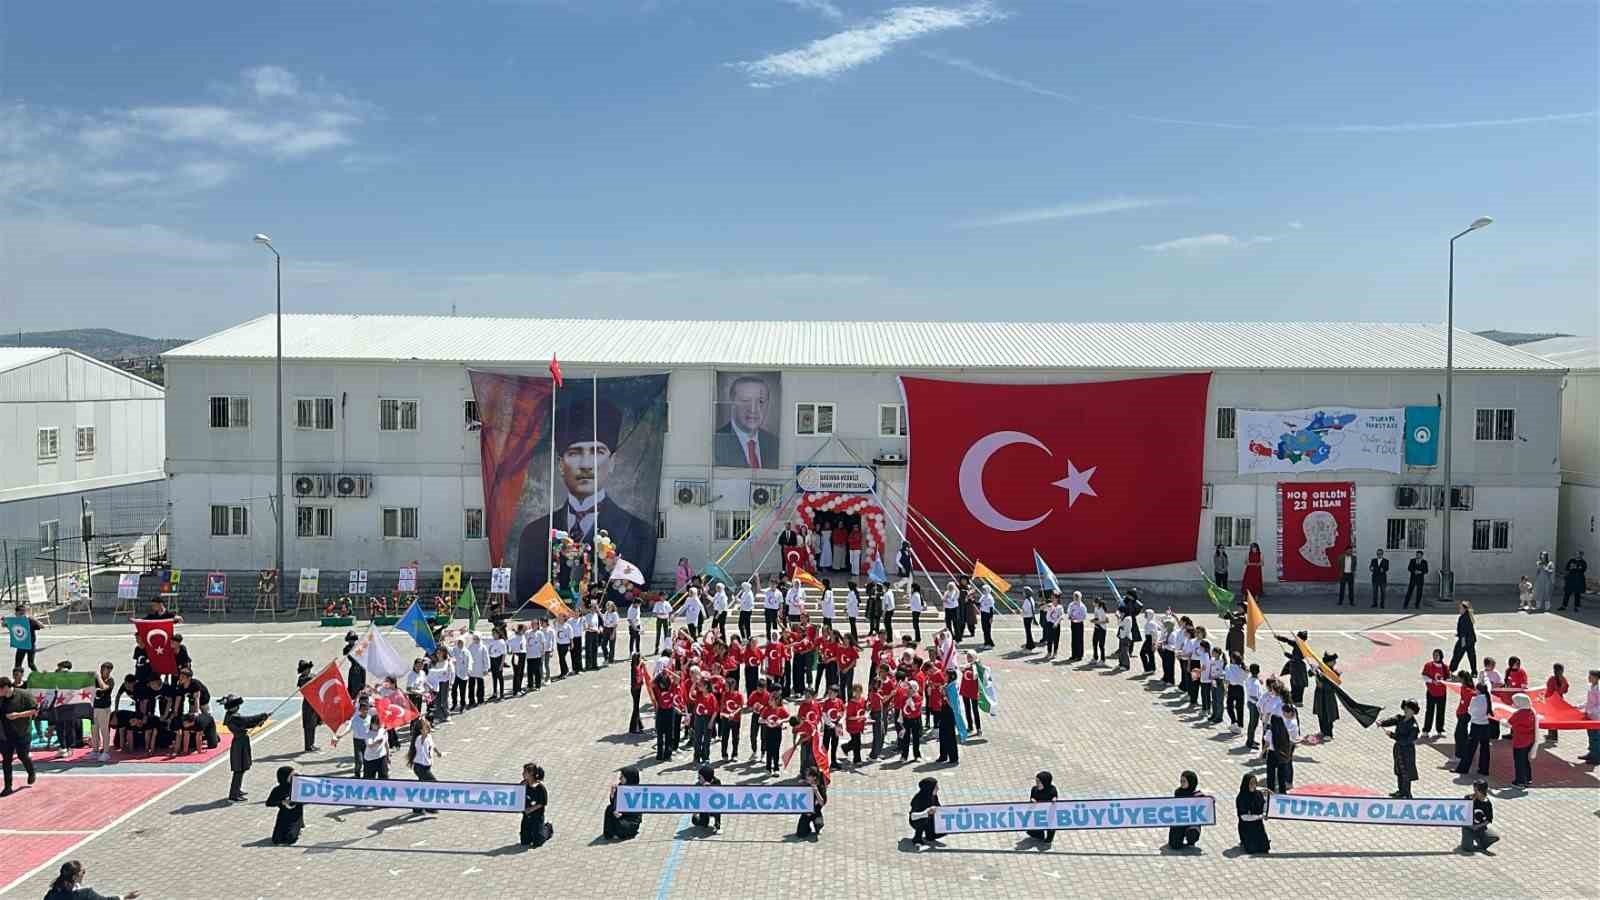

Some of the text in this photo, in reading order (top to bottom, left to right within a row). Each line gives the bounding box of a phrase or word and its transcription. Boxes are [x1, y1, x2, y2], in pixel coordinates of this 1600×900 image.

[1287, 489, 1347, 500] HOŞ GELDİN
[1293, 499, 1342, 510] 23 NİSAN
[300, 780, 517, 807] DÜŞMAN YURTLARI
[624, 788, 807, 810] VİRAN OLACAK
[941, 803, 1208, 831] TÜRKİYE BÜYÜYECEK
[1275, 798, 1466, 822] TURAN OLACAK
